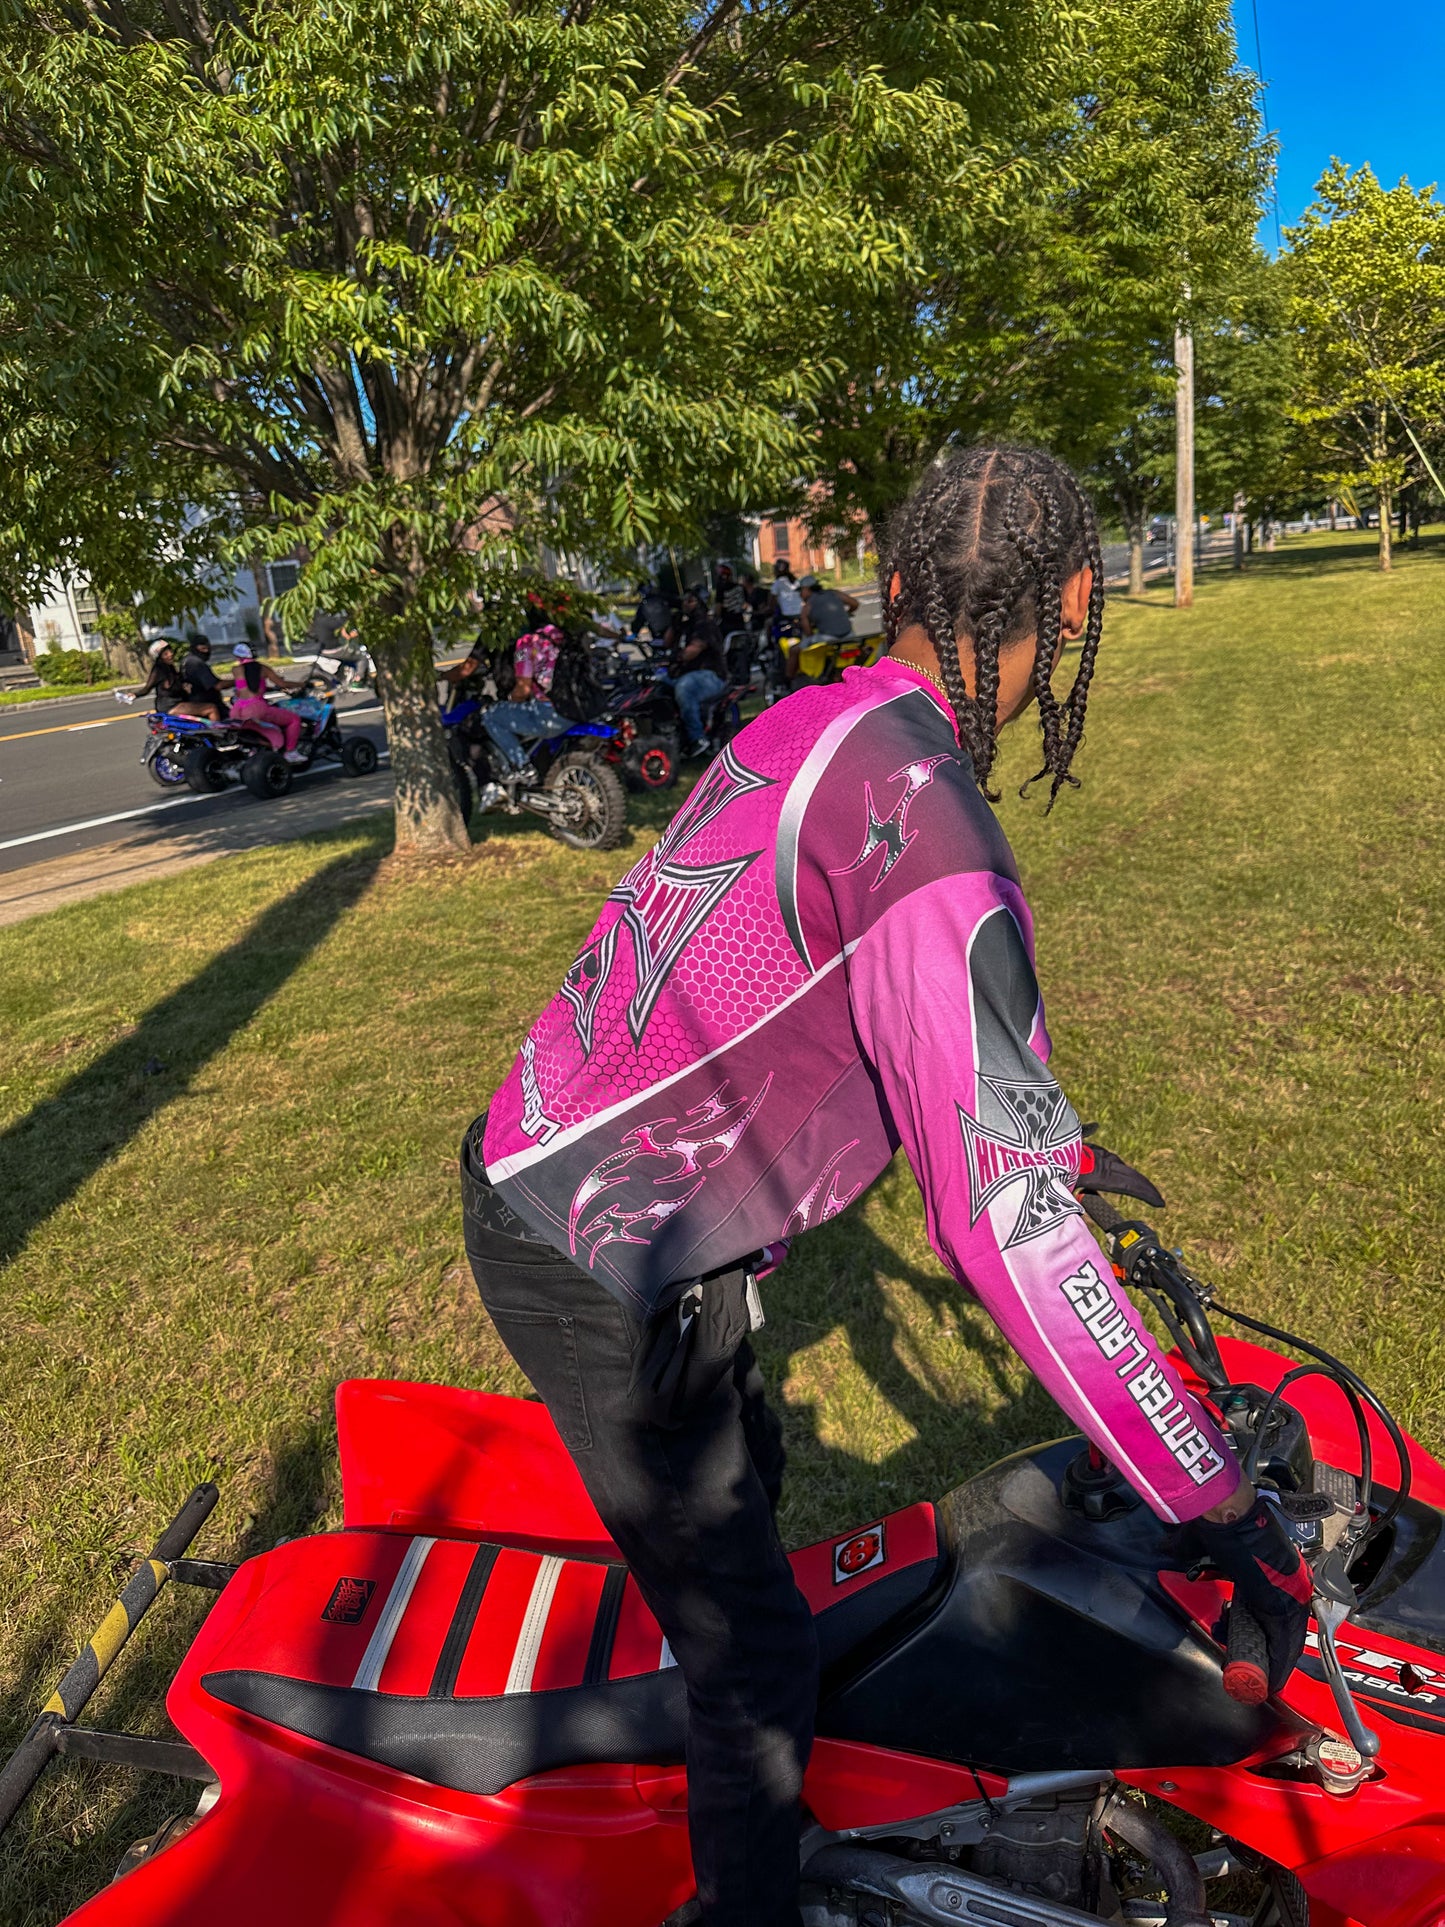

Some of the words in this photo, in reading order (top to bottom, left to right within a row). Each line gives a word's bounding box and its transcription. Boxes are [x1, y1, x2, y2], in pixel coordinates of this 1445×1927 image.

[975, 1134, 1049, 1190] HITTAS
[1059, 1260, 1149, 1379] LANEZ
[1125, 1358, 1226, 1488] CENTER
[1341, 1671, 1438, 1704] 450R
